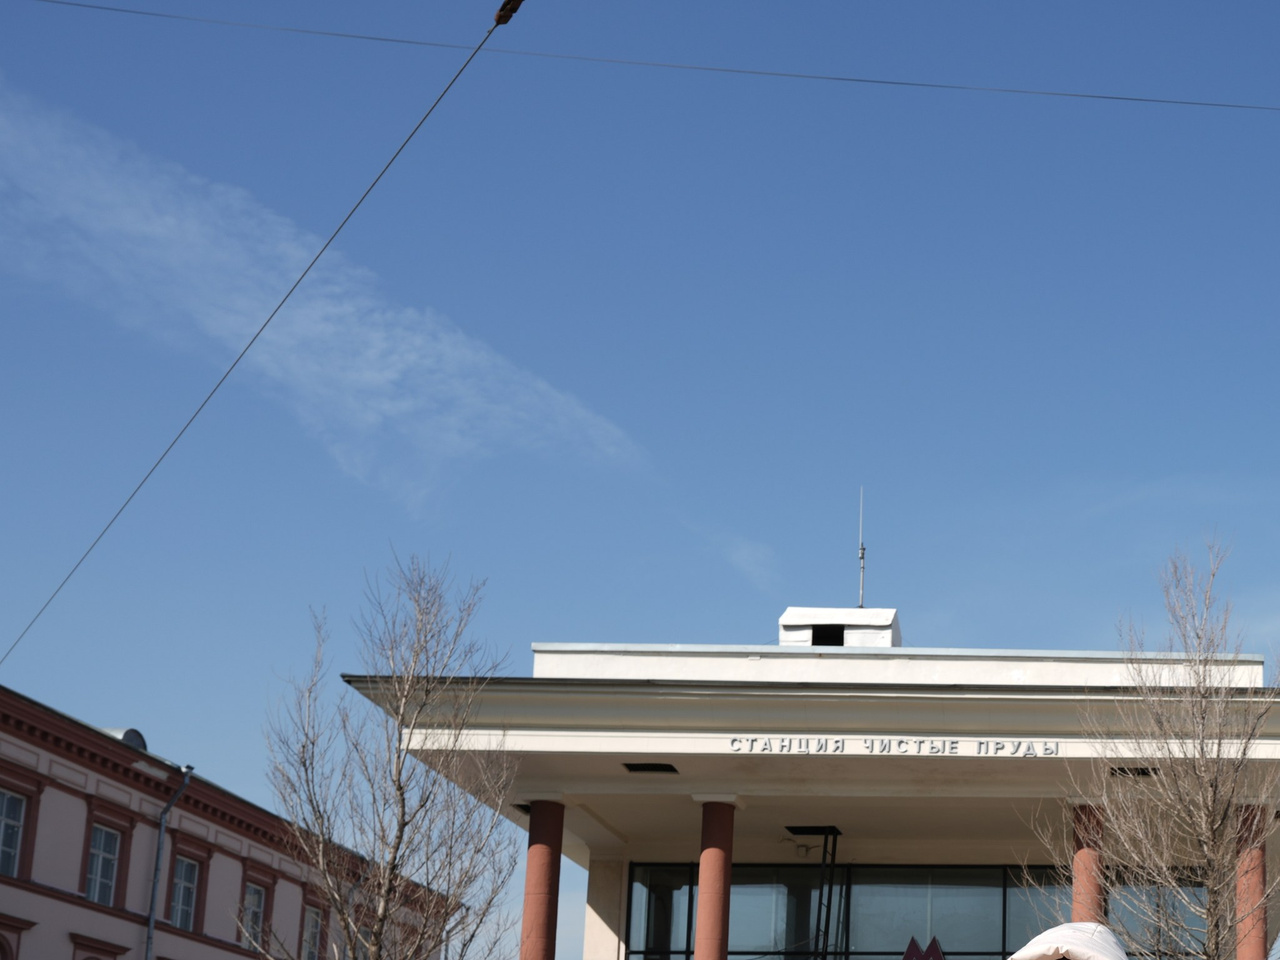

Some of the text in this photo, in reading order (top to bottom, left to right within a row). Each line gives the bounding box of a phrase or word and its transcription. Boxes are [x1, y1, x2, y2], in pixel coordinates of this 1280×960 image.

[729, 737, 1059, 758] СТАНЦИЯ ЧИСТЫЕ ПРУДЫ
